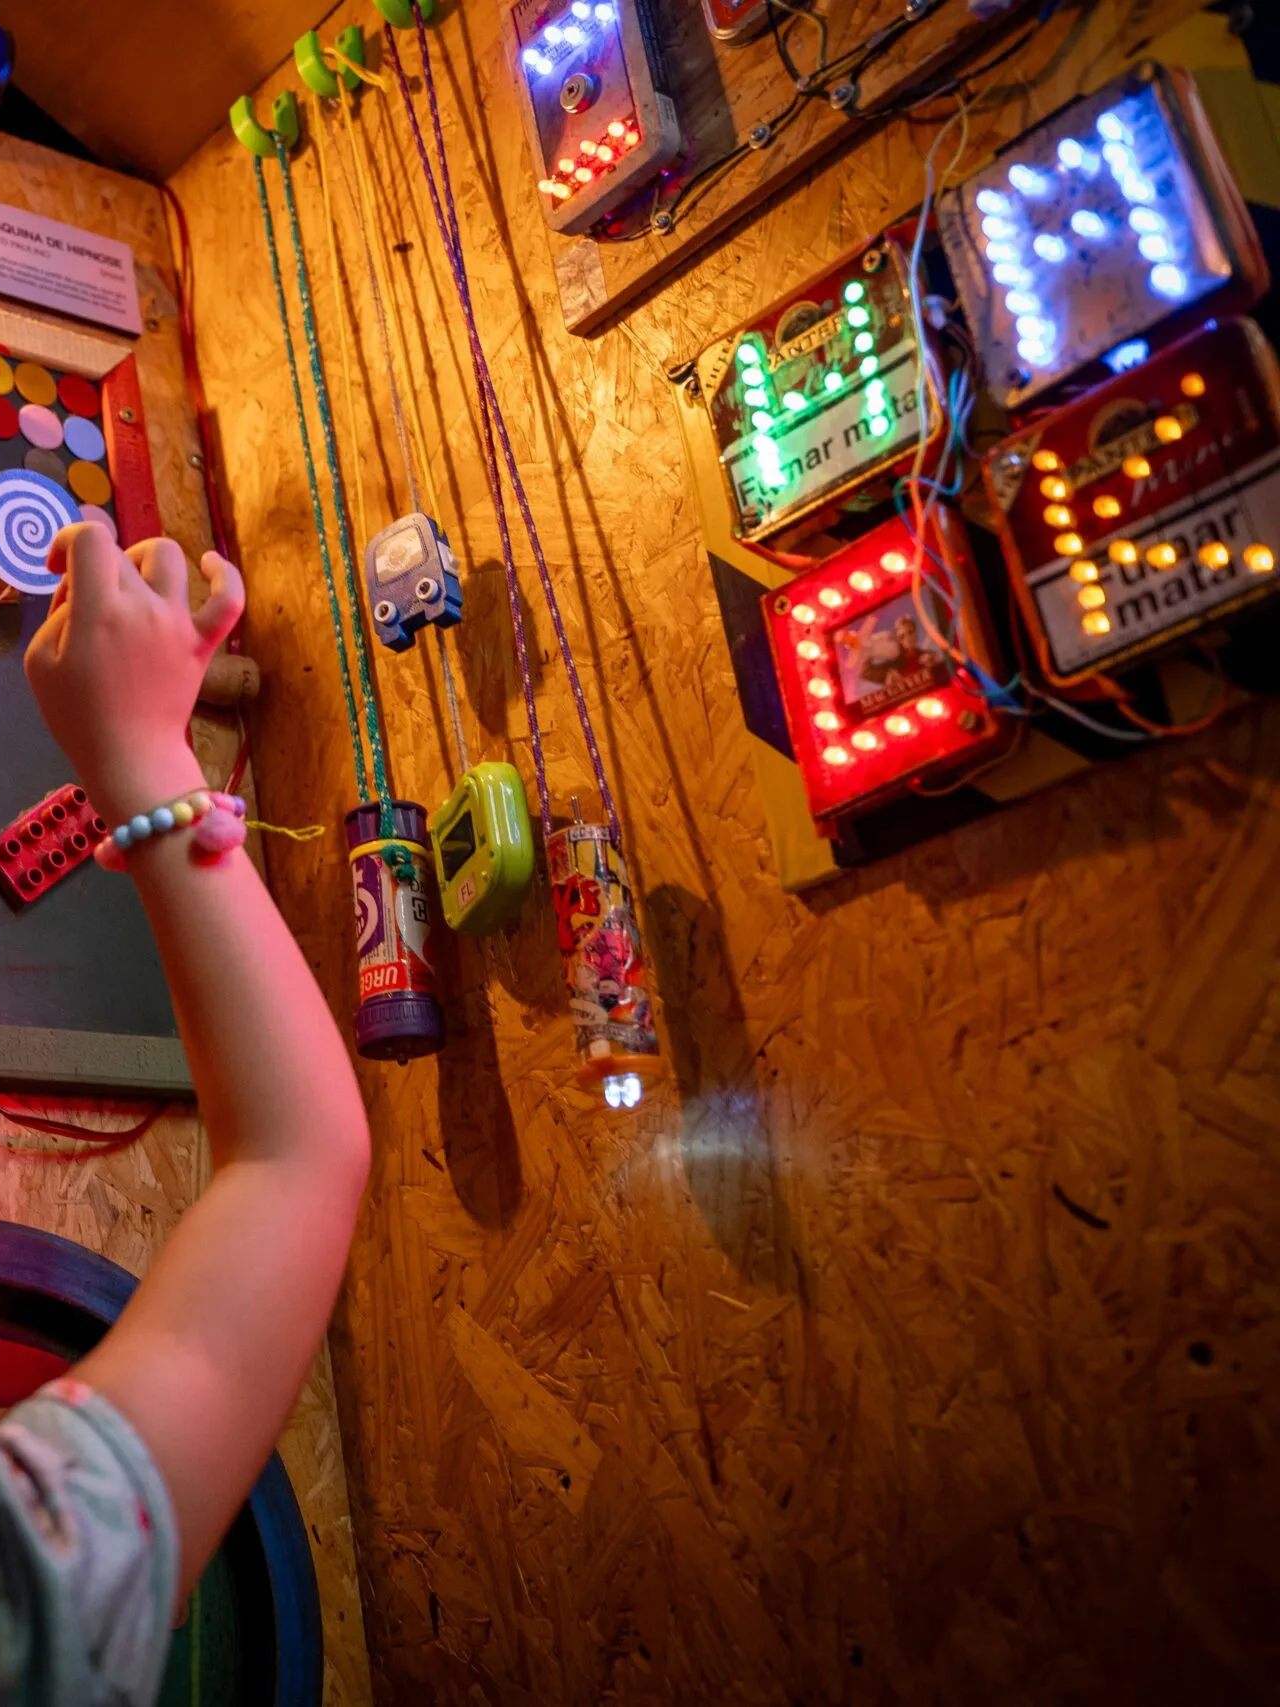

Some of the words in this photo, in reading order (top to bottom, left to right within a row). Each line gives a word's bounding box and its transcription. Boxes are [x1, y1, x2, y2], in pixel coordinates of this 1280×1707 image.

[45, 235, 64, 251] DE
[65, 240, 123, 269] HIPNOSE
[843, 389, 919, 447] mta
[1117, 563, 1239, 629] mata
